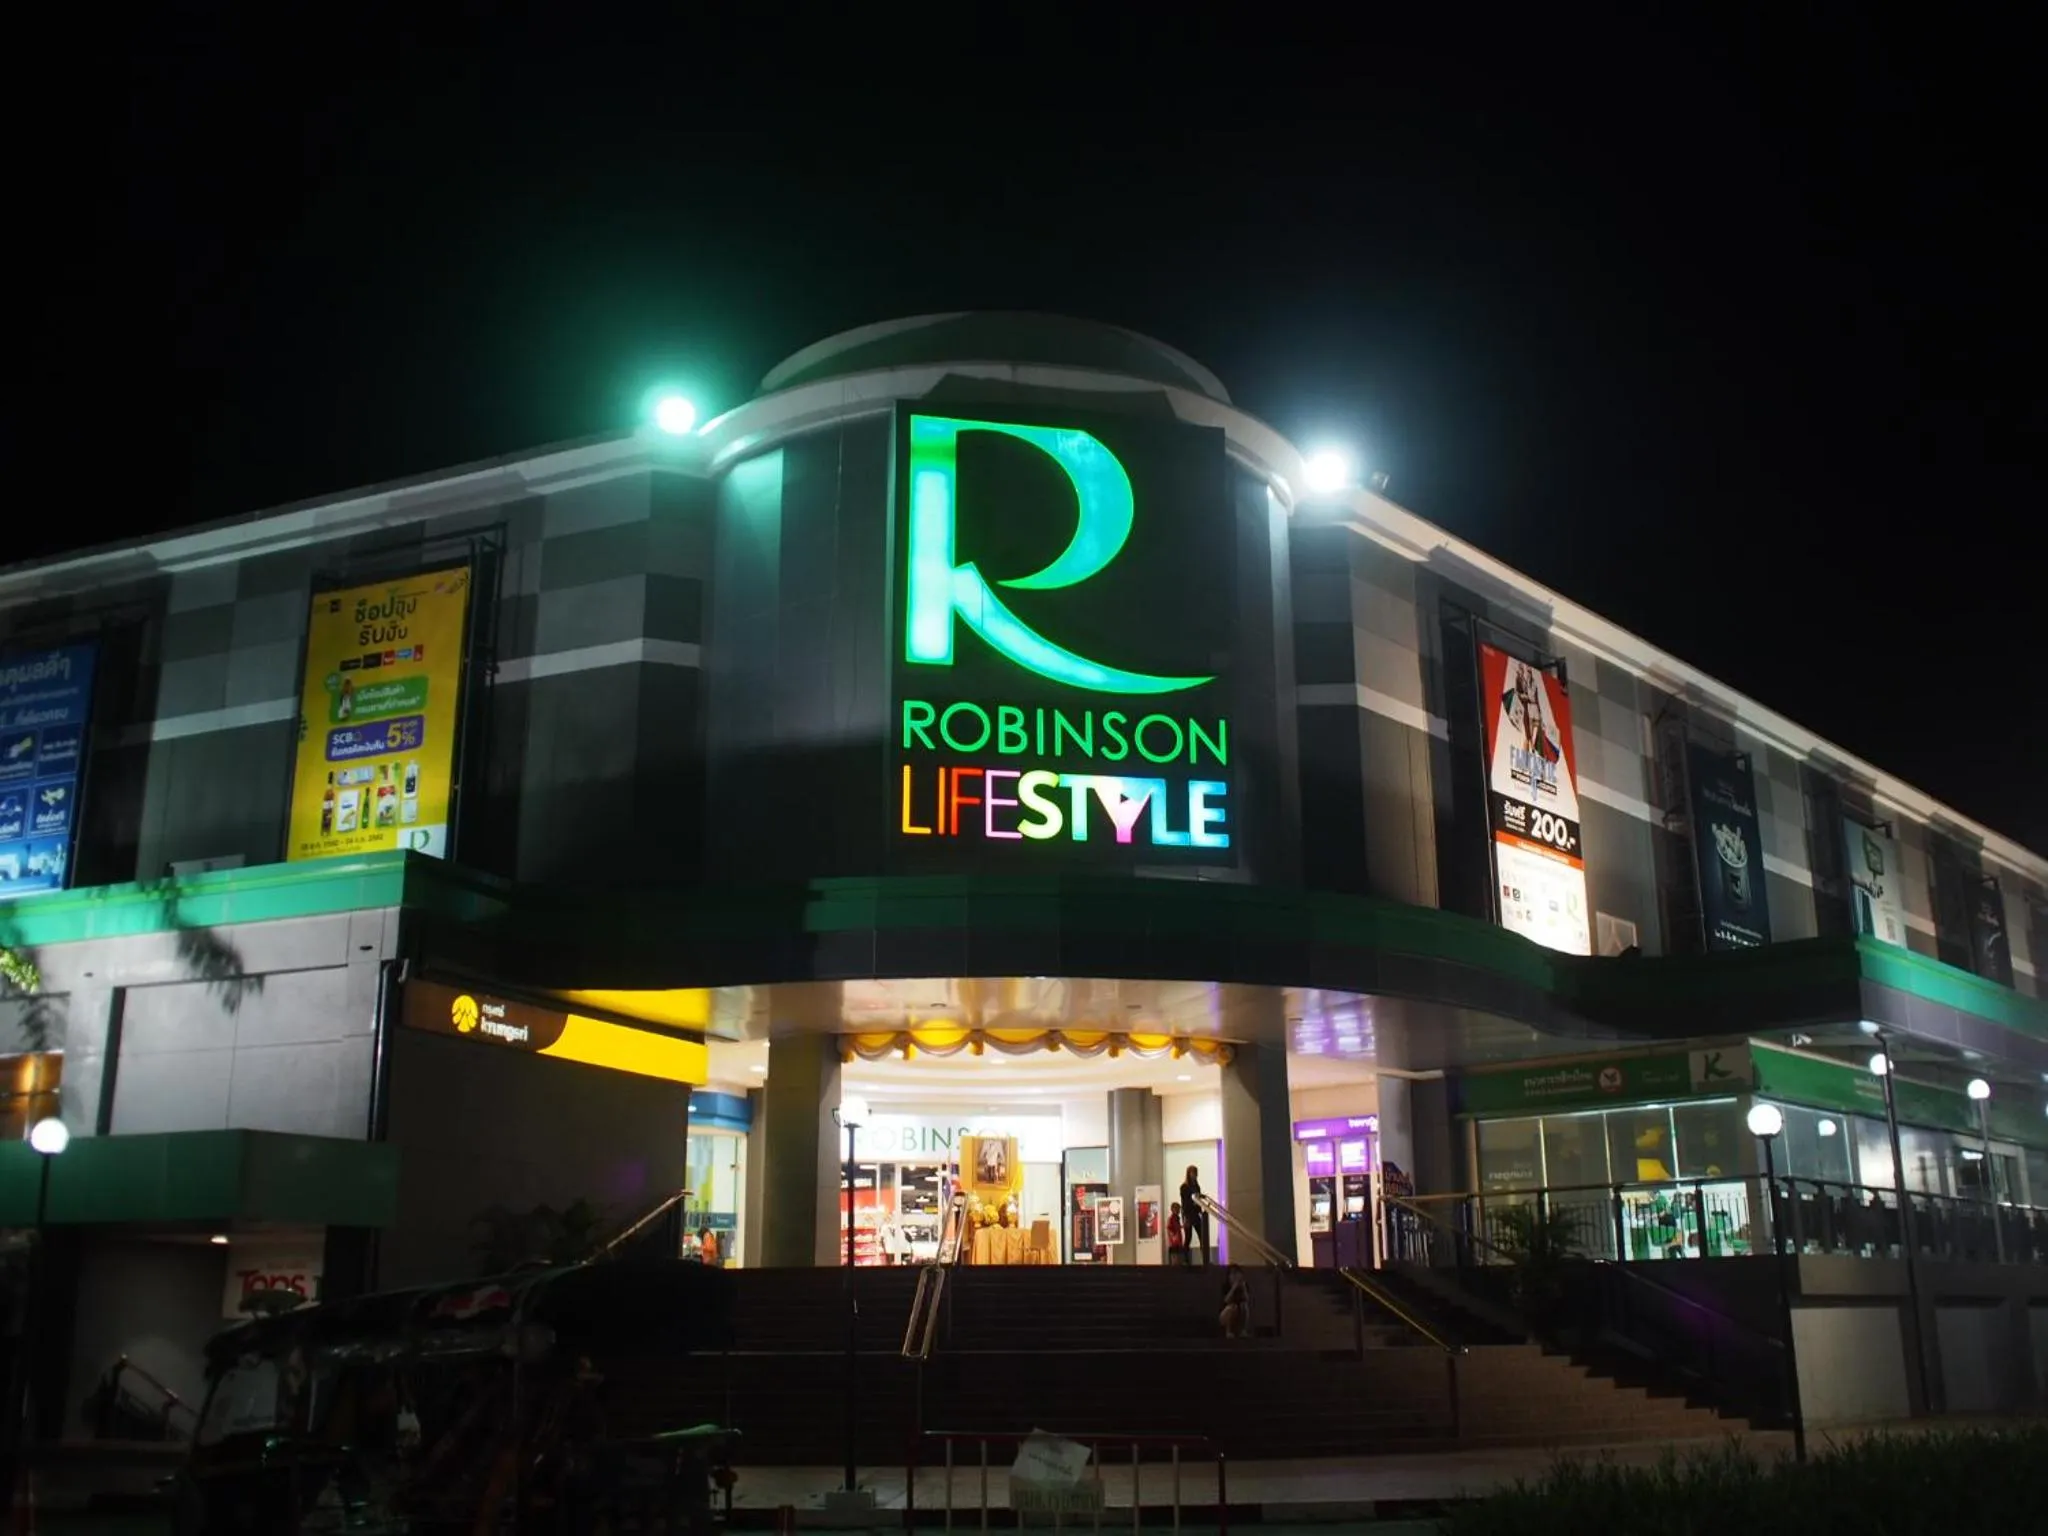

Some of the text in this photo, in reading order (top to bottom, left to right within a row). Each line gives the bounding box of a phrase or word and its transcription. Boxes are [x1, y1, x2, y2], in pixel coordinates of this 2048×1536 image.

[906, 414, 1216, 694] R
[903, 700, 1226, 766] ROBINSON
[902, 765, 1229, 847] LIFESTYLE
[480, 1016, 529, 1042] krungsri
[1704, 1052, 1733, 1080] K
